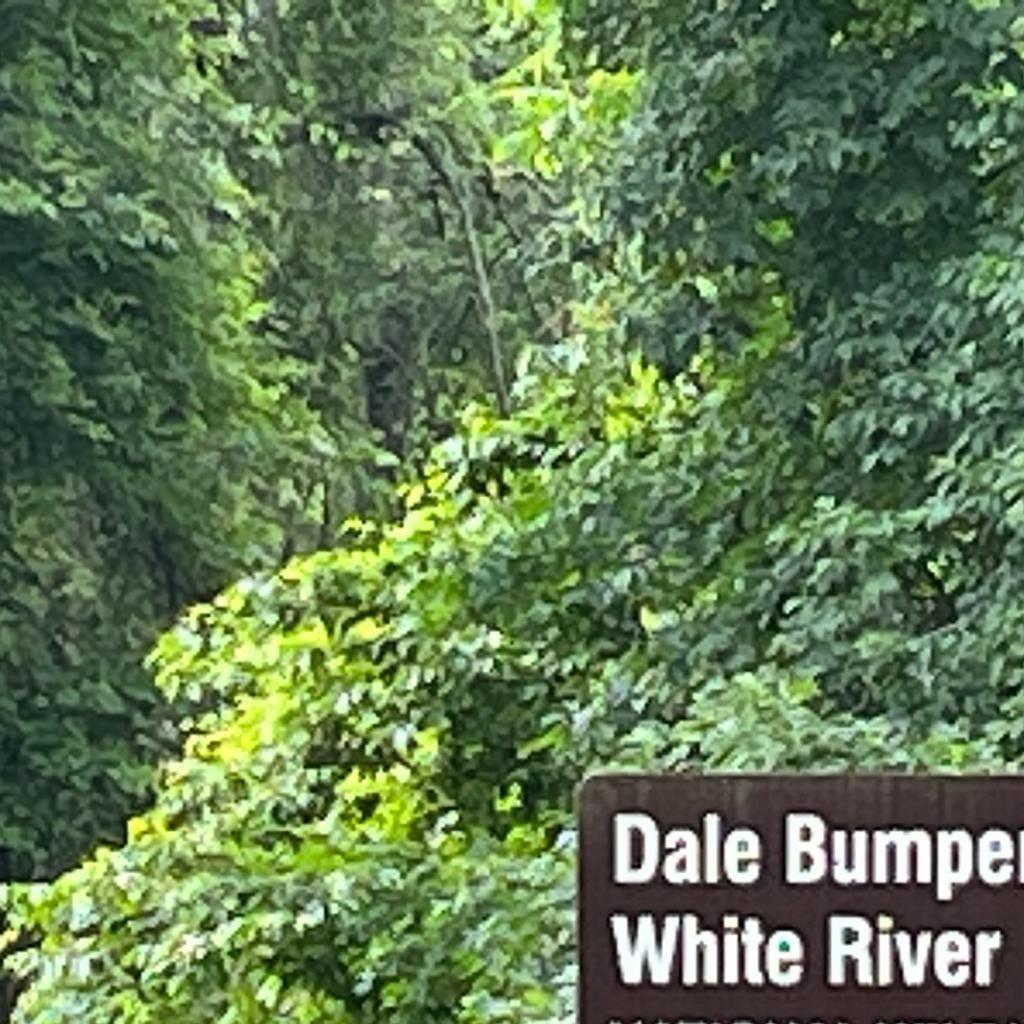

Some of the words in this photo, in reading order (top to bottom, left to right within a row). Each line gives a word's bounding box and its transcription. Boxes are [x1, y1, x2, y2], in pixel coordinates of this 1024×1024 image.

[612, 813, 762, 886] Dale
[611, 914, 804, 988] White
[828, 914, 1002, 988] River
